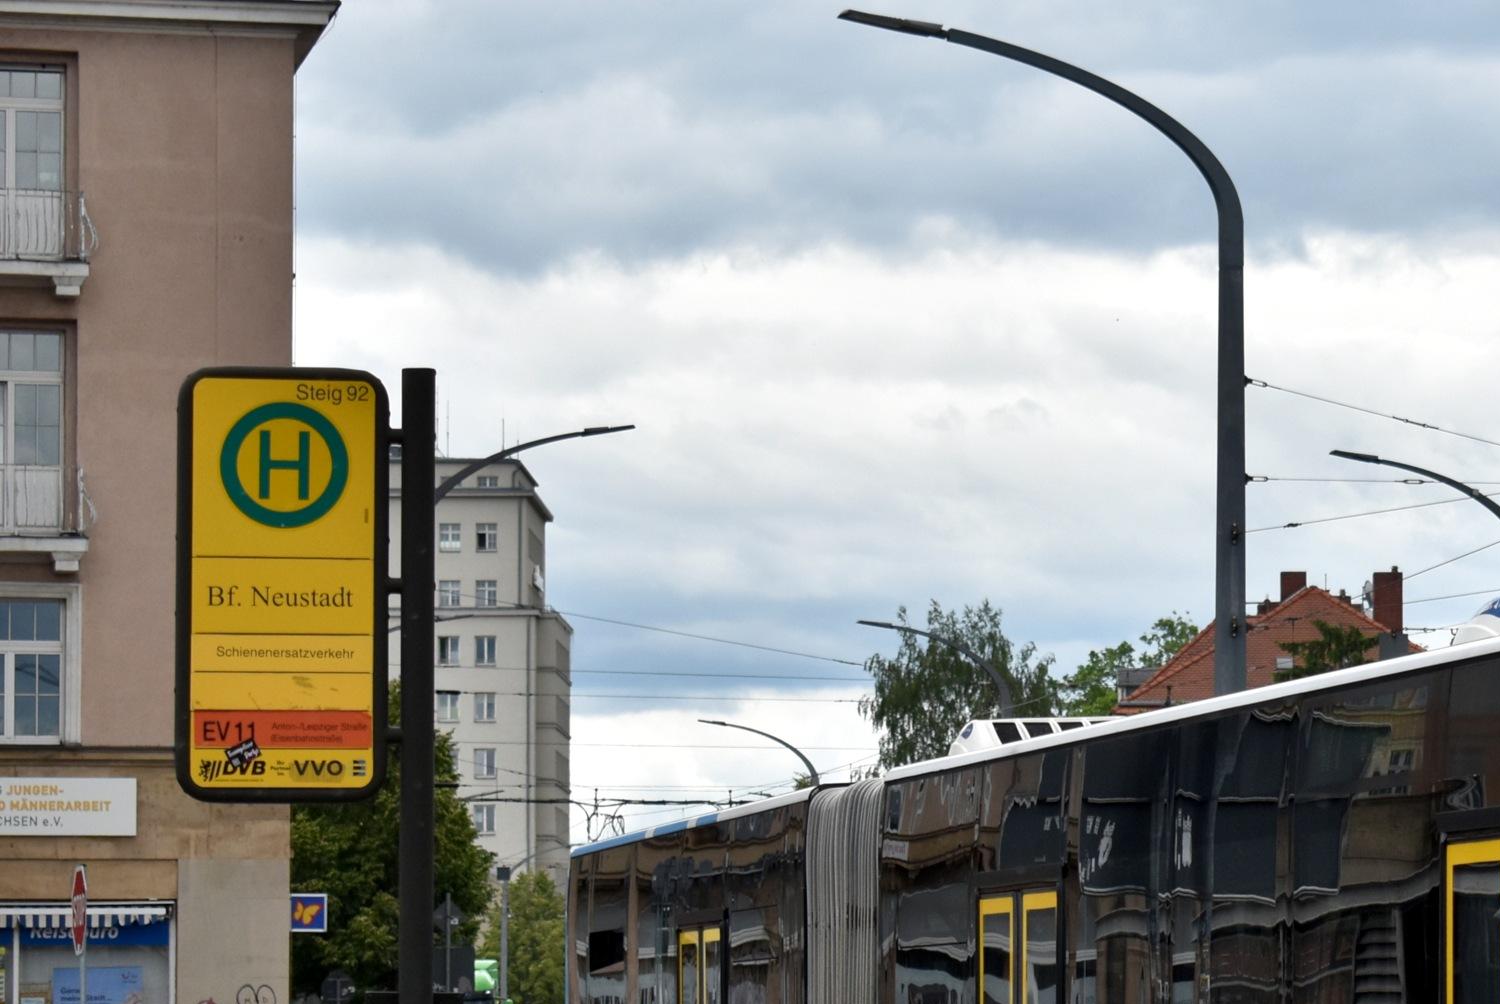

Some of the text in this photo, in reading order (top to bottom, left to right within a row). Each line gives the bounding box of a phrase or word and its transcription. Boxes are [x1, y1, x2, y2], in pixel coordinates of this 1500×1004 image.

[296, 384, 369, 405] Steig 92
[259, 430, 310, 500] H
[207, 586, 354, 608] Bf. Neustadt
[216, 646, 355, 662] Schienenersatzverkehr
[223, 760, 266, 775] DVB
[293, 760, 343, 776] VVO
[7, 785, 64, 796] JUNGEN-
[10, 798, 112, 812] MÄNNERARBEIT
